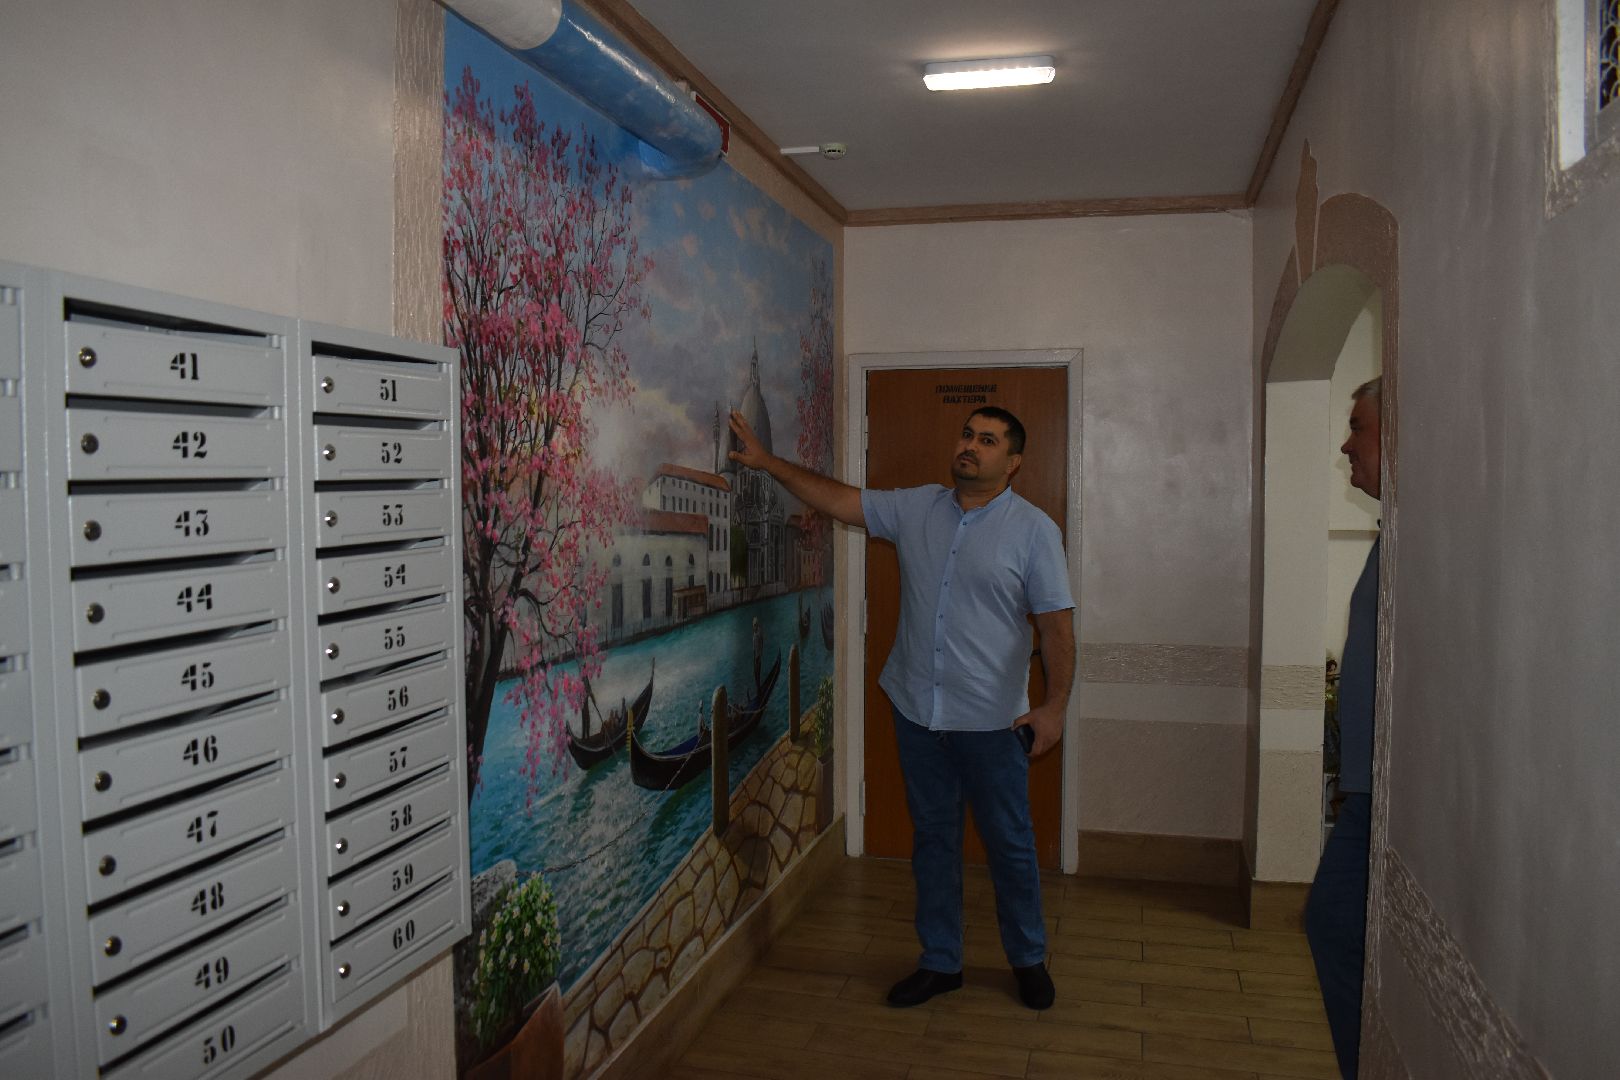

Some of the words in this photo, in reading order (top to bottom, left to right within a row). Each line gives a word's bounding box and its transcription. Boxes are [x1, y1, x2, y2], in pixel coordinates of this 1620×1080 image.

[170, 352, 199, 381] 41
[380, 379, 397, 401] 51
[173, 432, 207, 458] 42
[382, 442, 402, 463] 52
[175, 510, 209, 536] 43
[383, 504, 403, 526] 53
[385, 564, 405, 587] 54
[177, 584, 212, 612] 44
[385, 626, 405, 649] 55
[182, 663, 214, 691] 45
[388, 686, 408, 710] 56
[184, 736, 218, 765] 46
[390, 747, 407, 772] 57
[187, 811, 218, 843] 47
[391, 804, 412, 831] 58
[393, 863, 413, 891] 59
[192, 883, 224, 915] 48
[393, 919, 415, 949] 60
[195, 957, 229, 989] 49
[204, 1026, 235, 1064] 50
